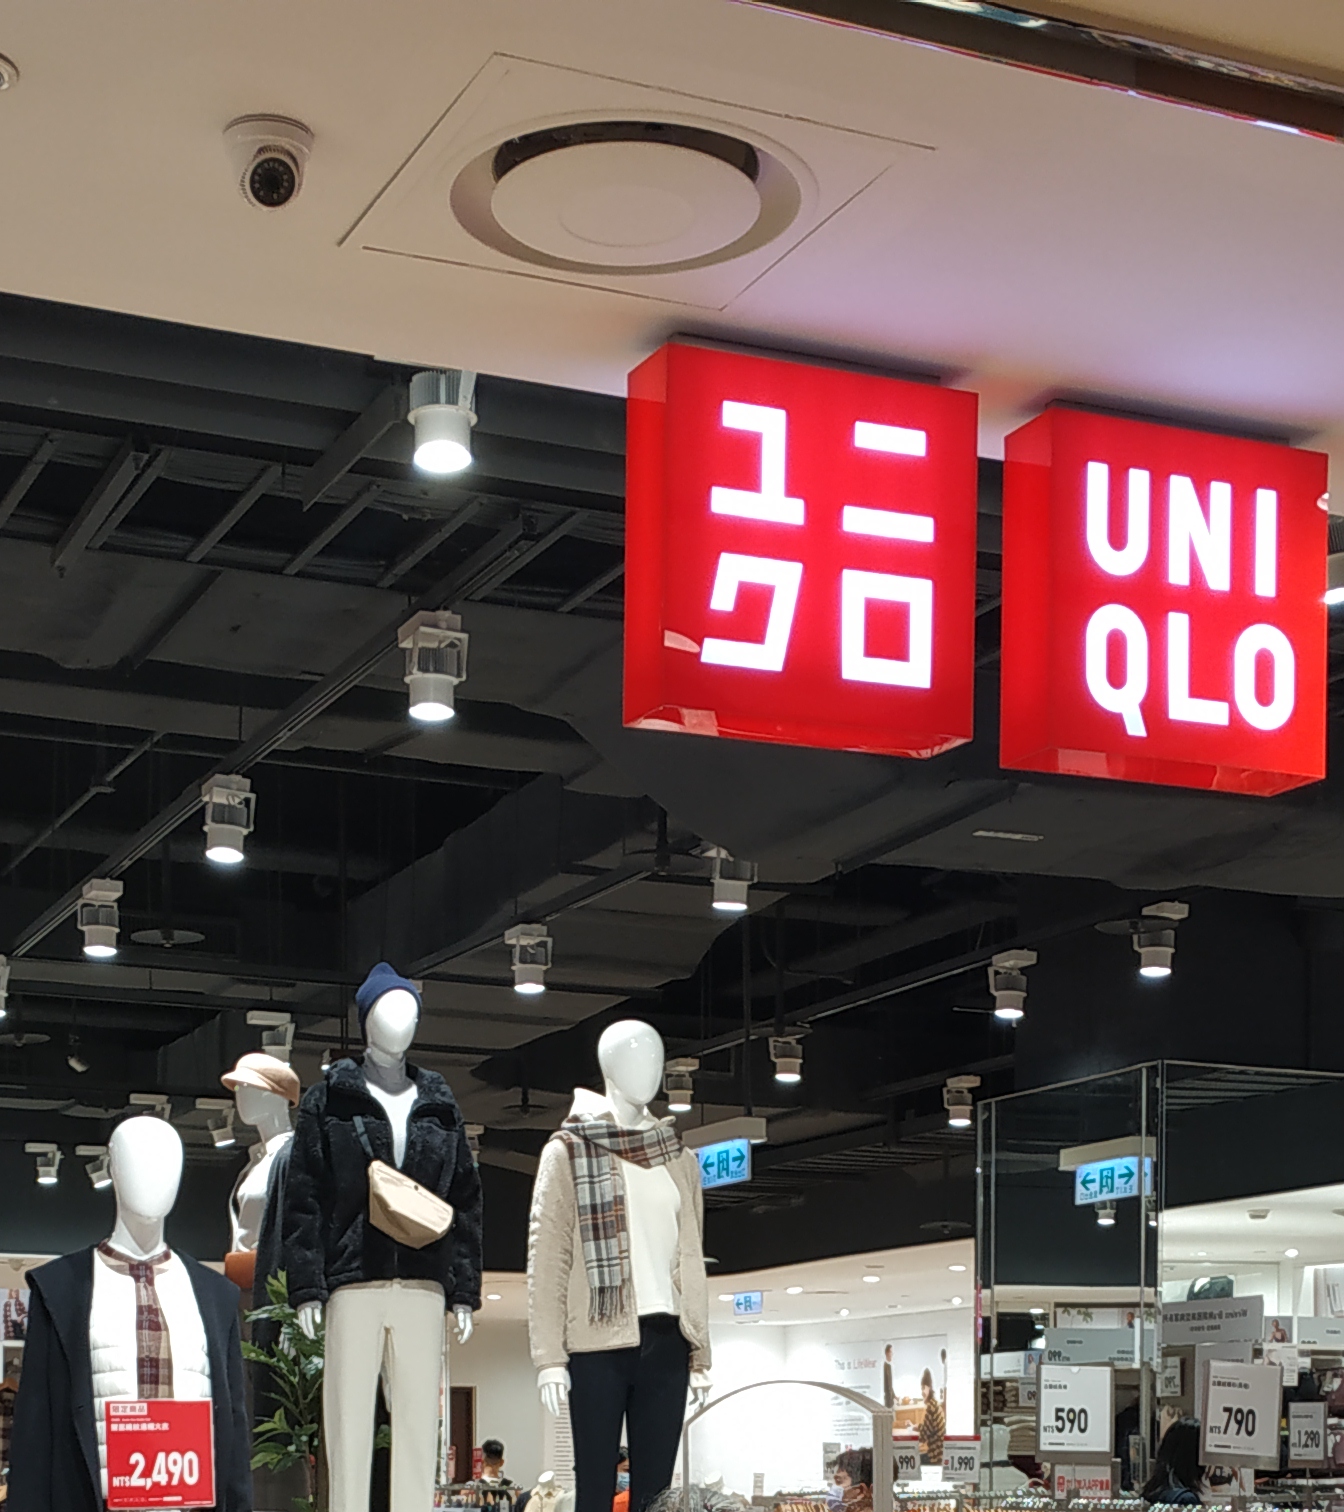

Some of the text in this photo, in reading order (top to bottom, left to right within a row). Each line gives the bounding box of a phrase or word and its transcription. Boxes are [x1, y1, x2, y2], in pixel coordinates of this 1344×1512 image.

[1085, 460, 1278, 598] UNI
[1085, 603, 1296, 738] QLO
[112, 1450, 199, 1491] NT$2,490
